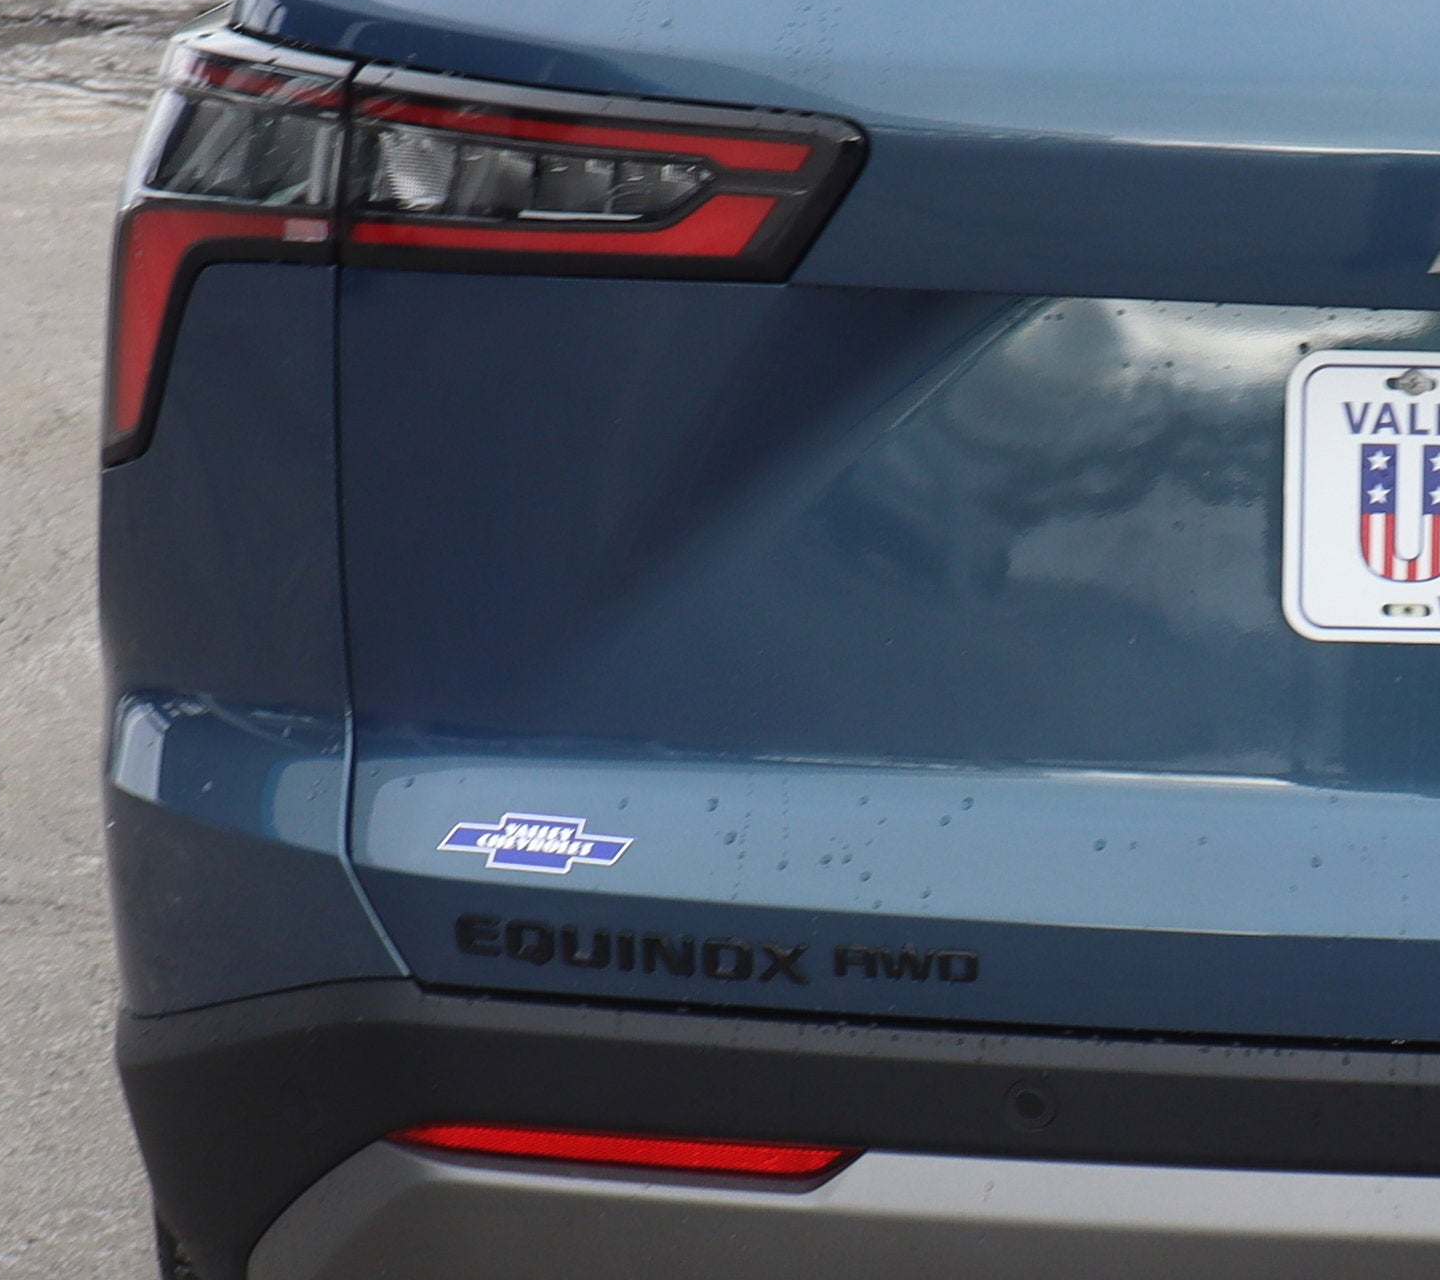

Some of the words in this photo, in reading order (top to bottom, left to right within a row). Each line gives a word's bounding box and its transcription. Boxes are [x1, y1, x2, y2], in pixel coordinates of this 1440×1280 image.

[505, 822, 575, 841] VALLEY
[476, 832, 594, 856] CHEVROLET
[454, 913, 810, 985] EQUINOX
[834, 942, 980, 984] AWD
